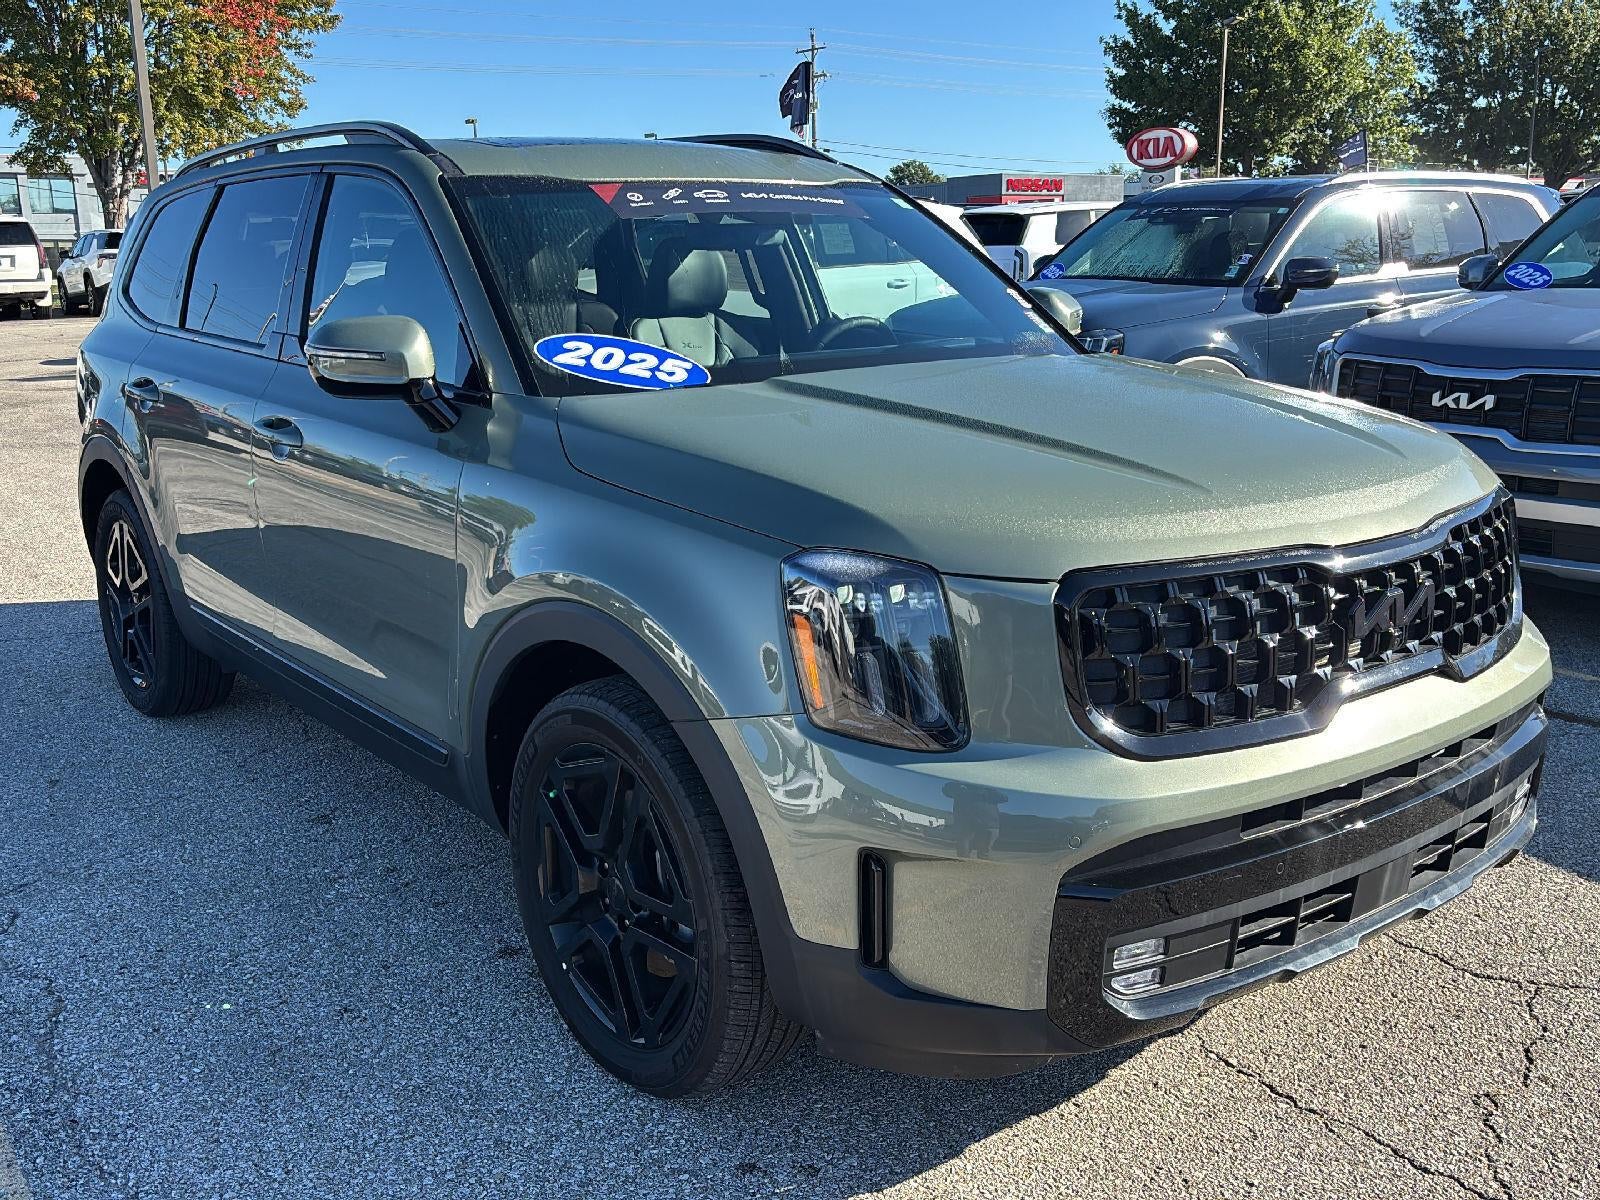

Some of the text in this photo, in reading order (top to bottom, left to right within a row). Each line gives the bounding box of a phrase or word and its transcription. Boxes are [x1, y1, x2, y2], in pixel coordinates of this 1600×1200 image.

[1136, 135, 1177, 161] KIA
[1006, 178, 1063, 193] NISSAN
[1507, 264, 1550, 286] 2025
[552, 340, 693, 384] 2025
[1432, 390, 1495, 411] KIA
